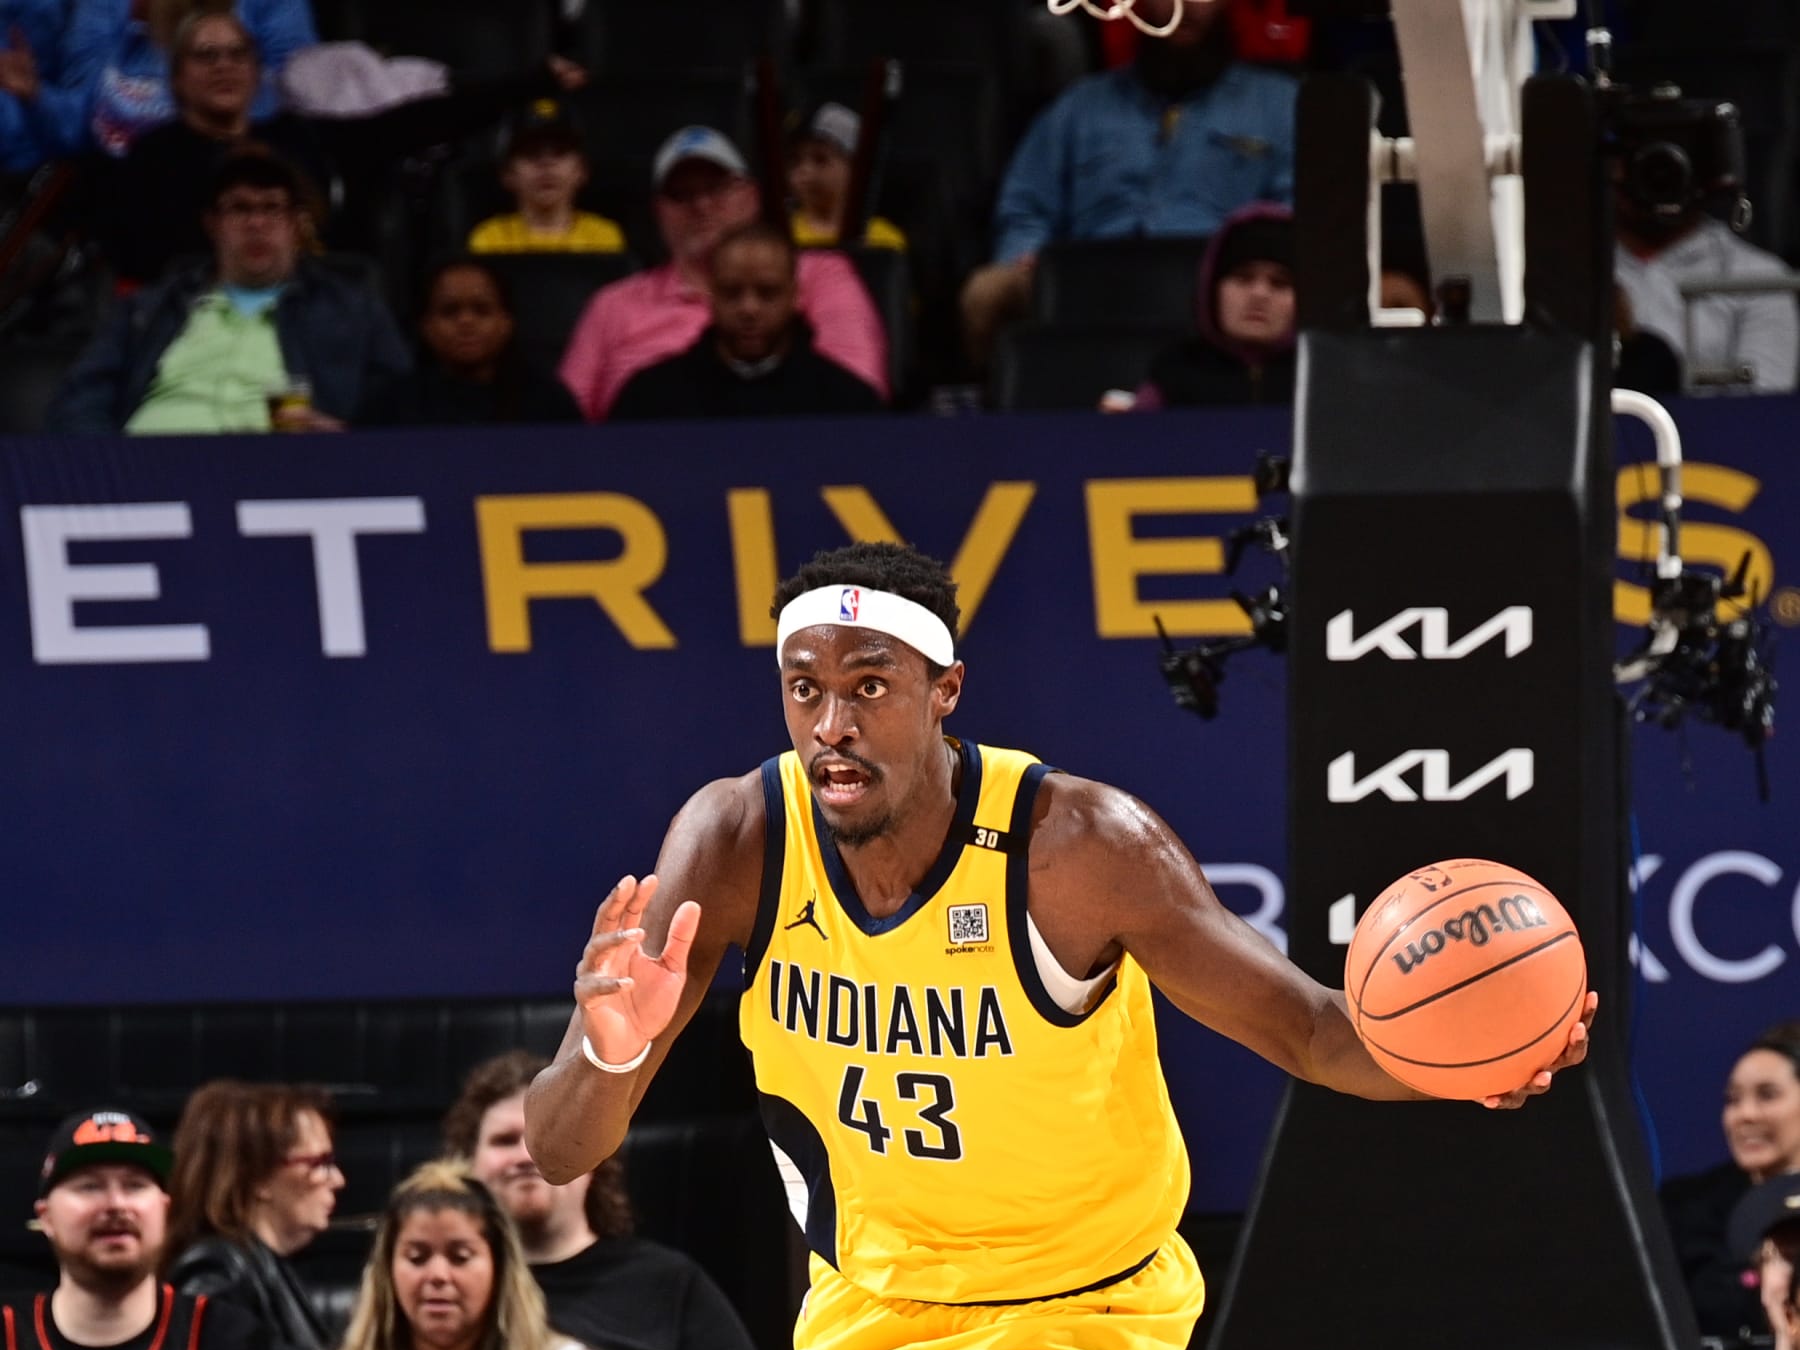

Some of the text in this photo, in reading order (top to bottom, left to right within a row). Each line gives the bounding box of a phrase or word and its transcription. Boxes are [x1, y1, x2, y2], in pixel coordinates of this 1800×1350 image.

[974, 827, 999, 849] 30
[944, 945, 995, 957] spokenote
[1391, 894, 1548, 975] Wilson
[770, 959, 1015, 1058] INDIANA
[838, 1064, 964, 1161] 43
